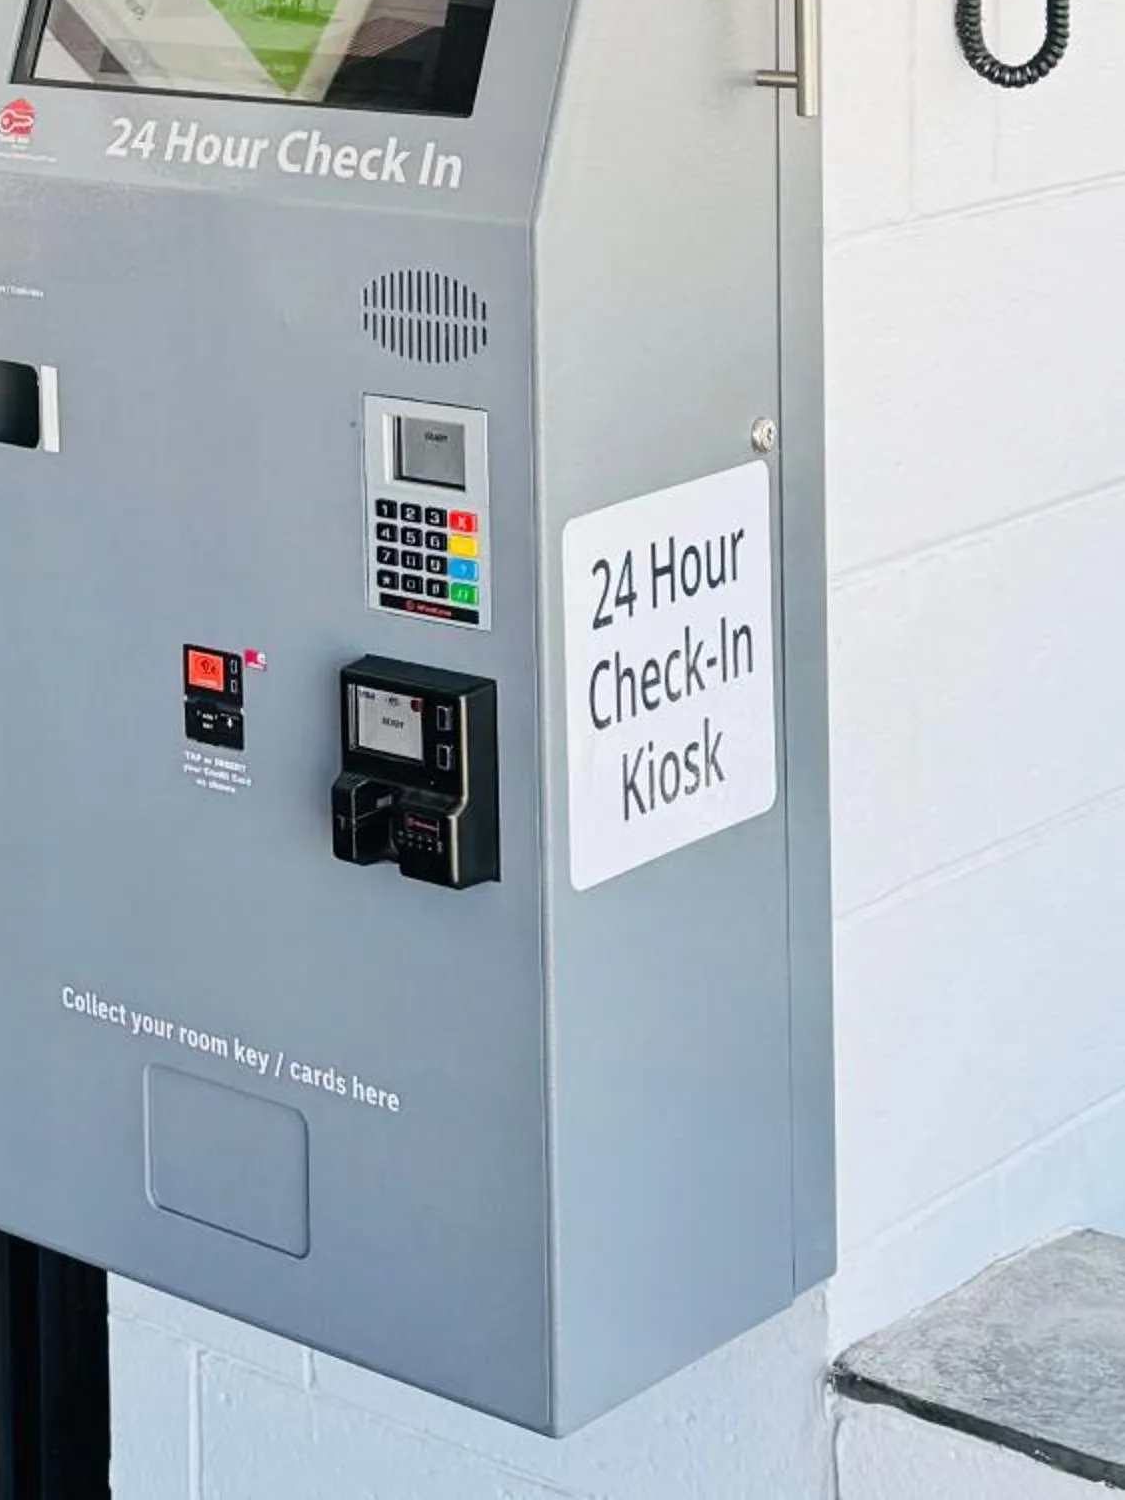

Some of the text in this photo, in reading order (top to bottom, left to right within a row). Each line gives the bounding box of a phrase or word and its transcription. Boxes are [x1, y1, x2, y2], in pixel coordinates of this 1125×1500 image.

[106, 118, 461, 188] 24 Hour Check In
[592, 529, 744, 630] 24 Hour
[589, 617, 752, 730] Check-In
[623, 718, 724, 821] Kiosk
[63, 987, 399, 1111] Collect your room key cards here
